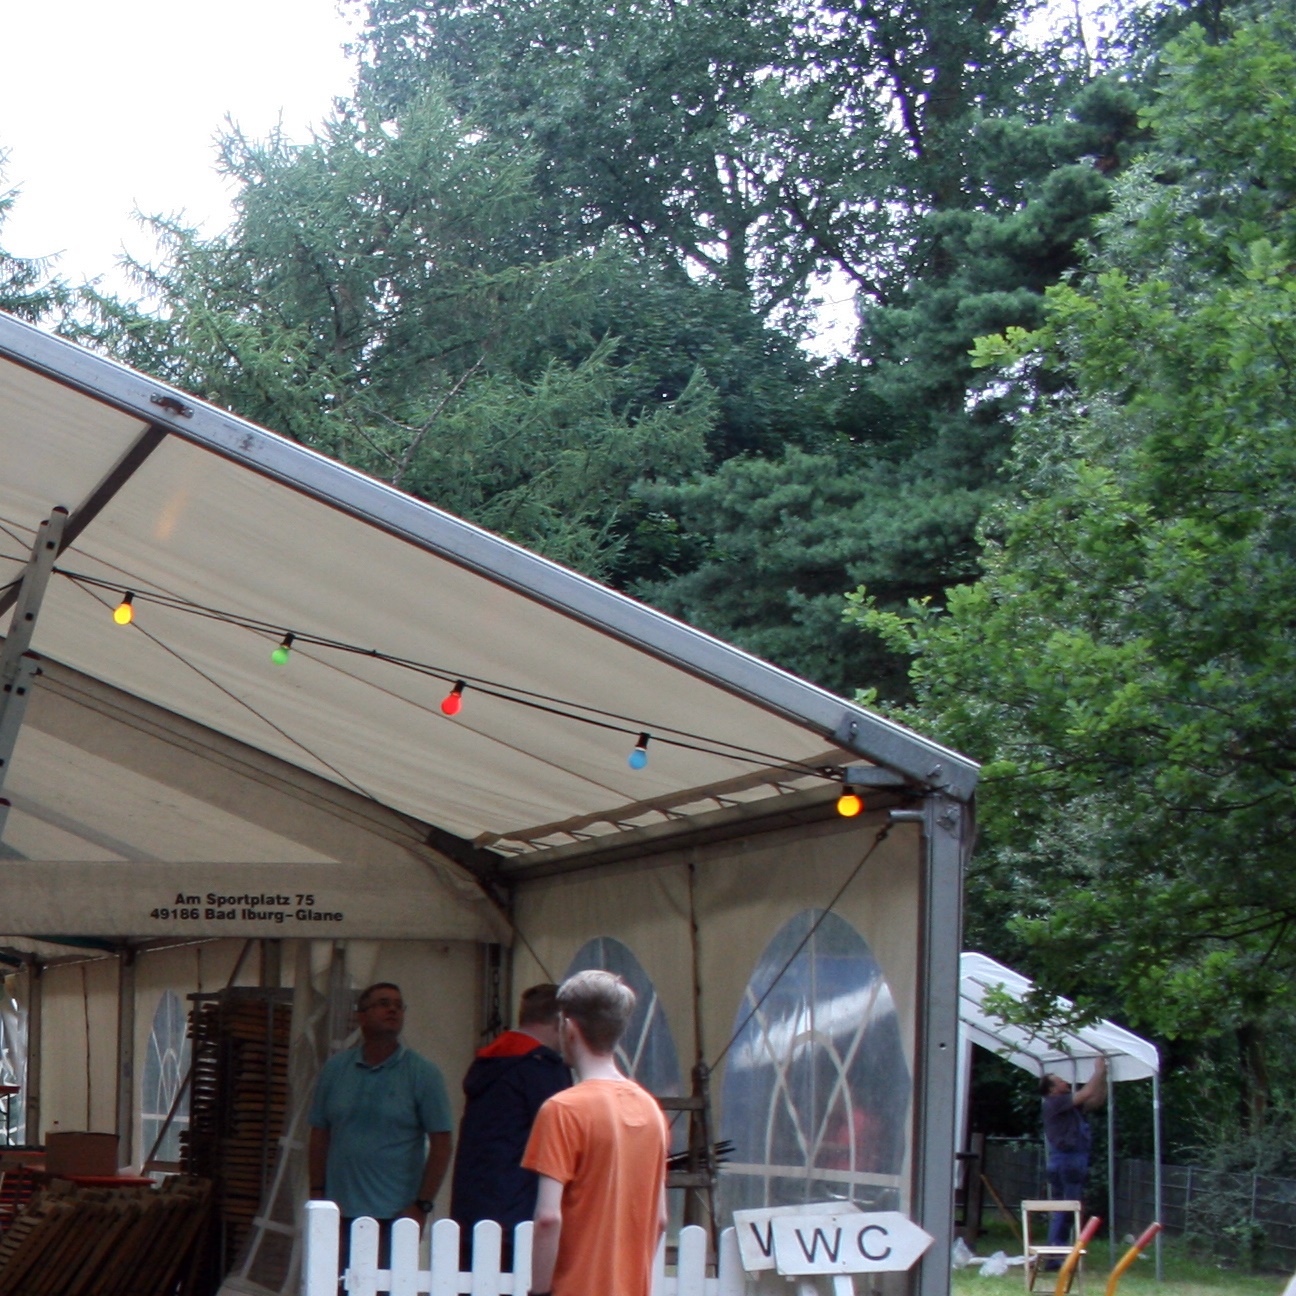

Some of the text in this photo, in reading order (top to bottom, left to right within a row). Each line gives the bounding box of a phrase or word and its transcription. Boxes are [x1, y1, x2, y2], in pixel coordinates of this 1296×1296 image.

[174, 892, 315, 907] Am Sportplatz 75
[150, 906, 344, 923] 49186 Bad Iburg-Glane
[795, 1224, 892, 1265] WC
